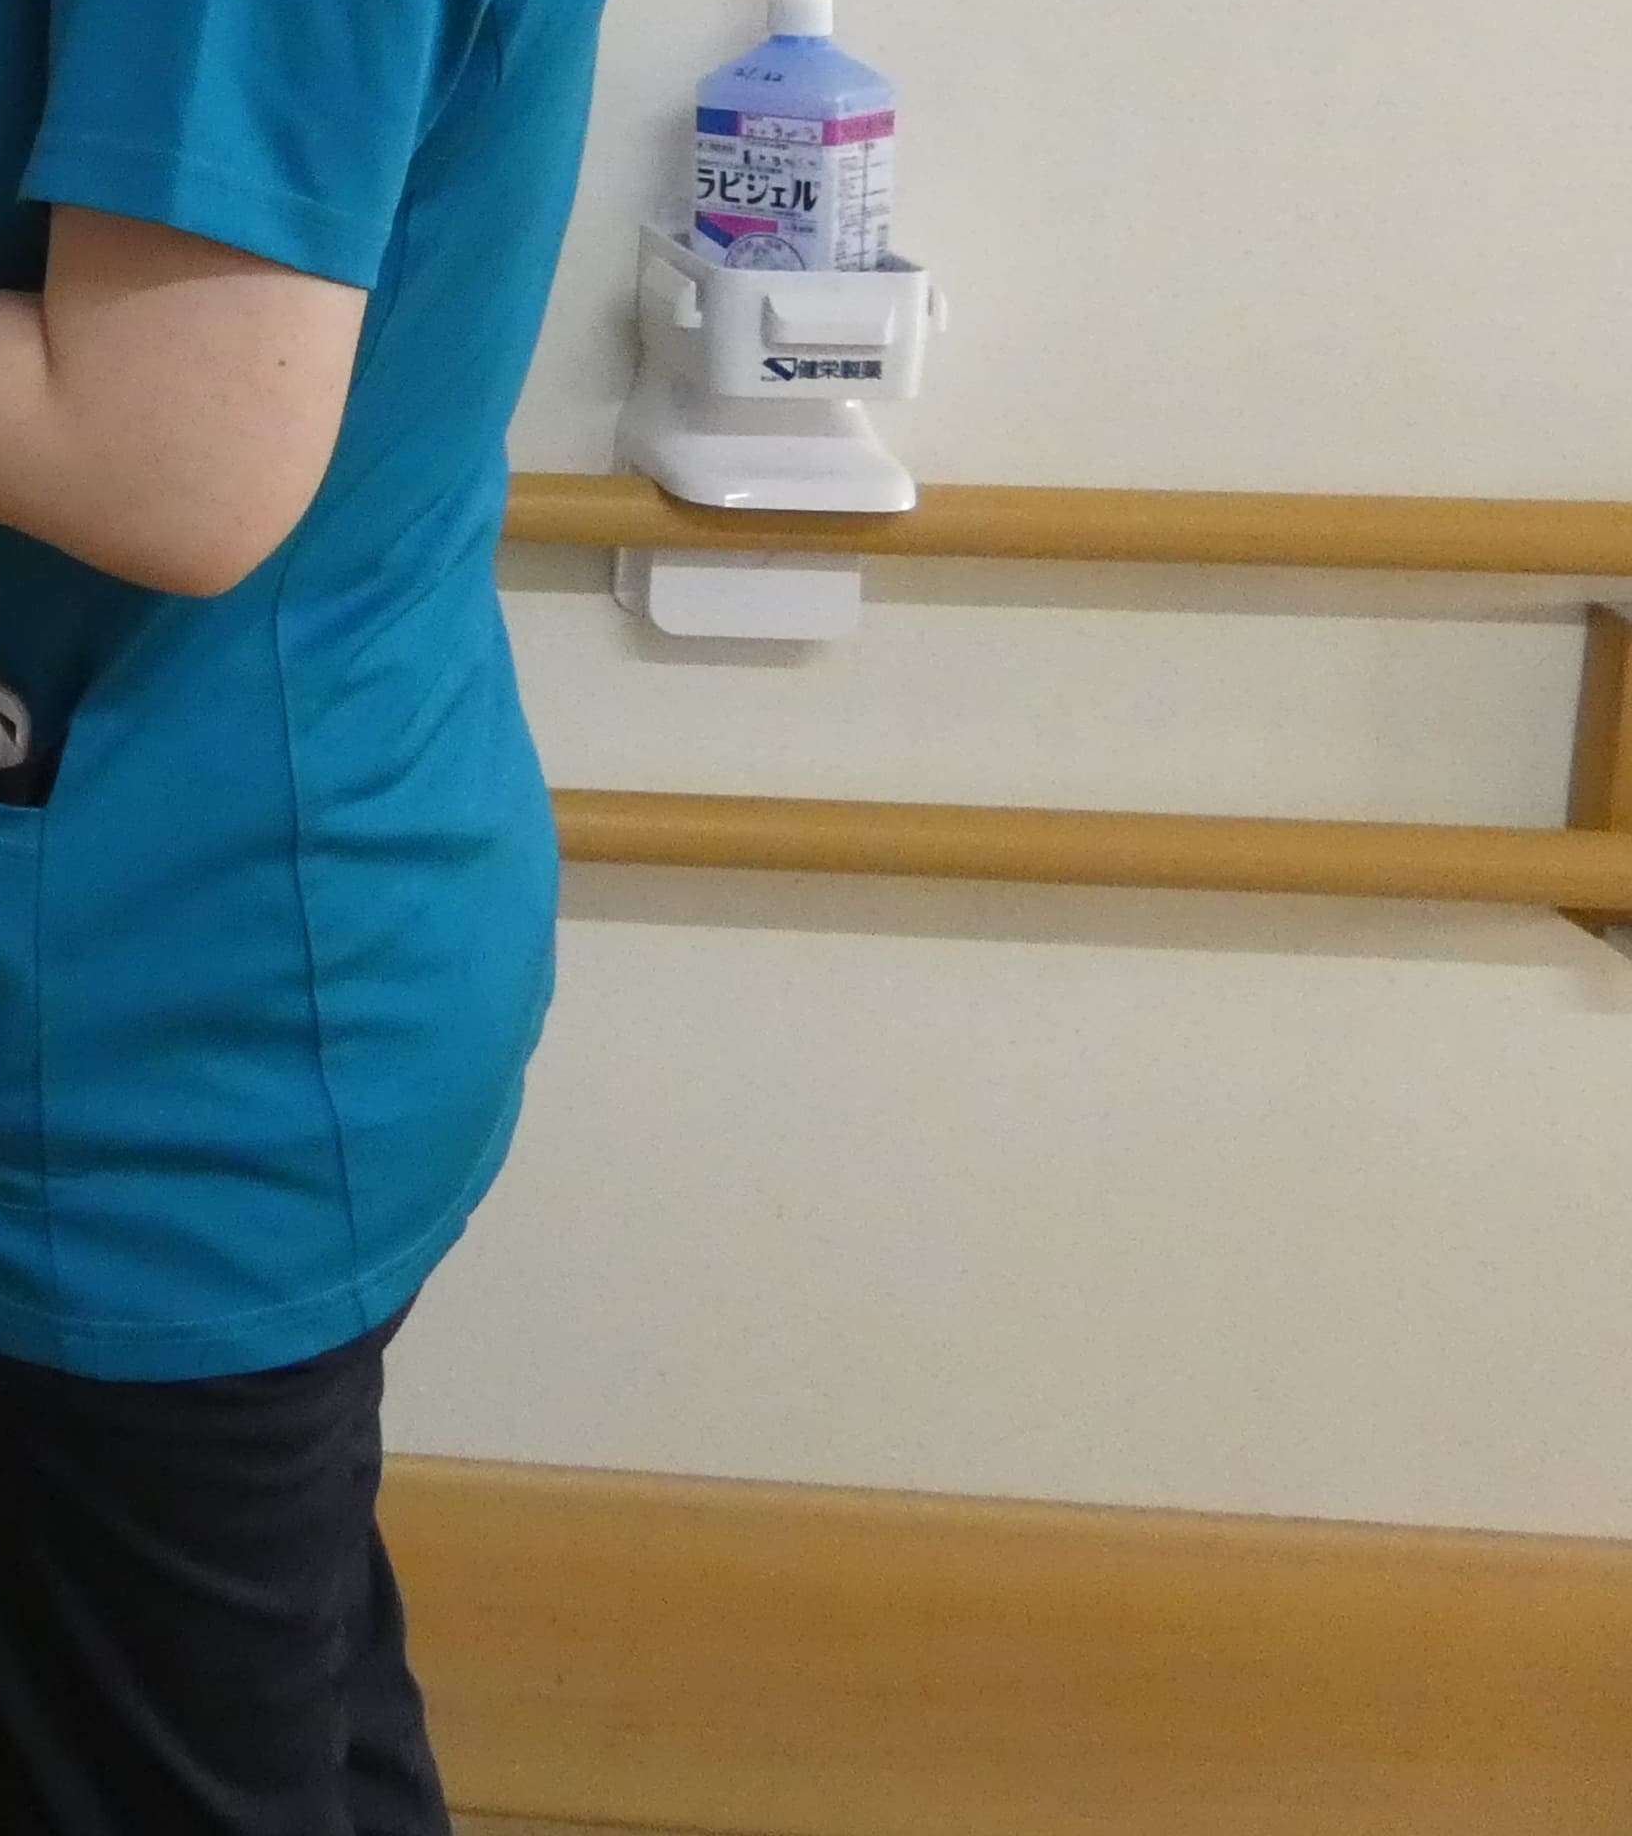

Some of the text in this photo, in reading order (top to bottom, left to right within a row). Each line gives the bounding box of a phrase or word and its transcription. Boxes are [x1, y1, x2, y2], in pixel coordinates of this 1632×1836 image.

[696, 167, 818, 212] ラビジェル
